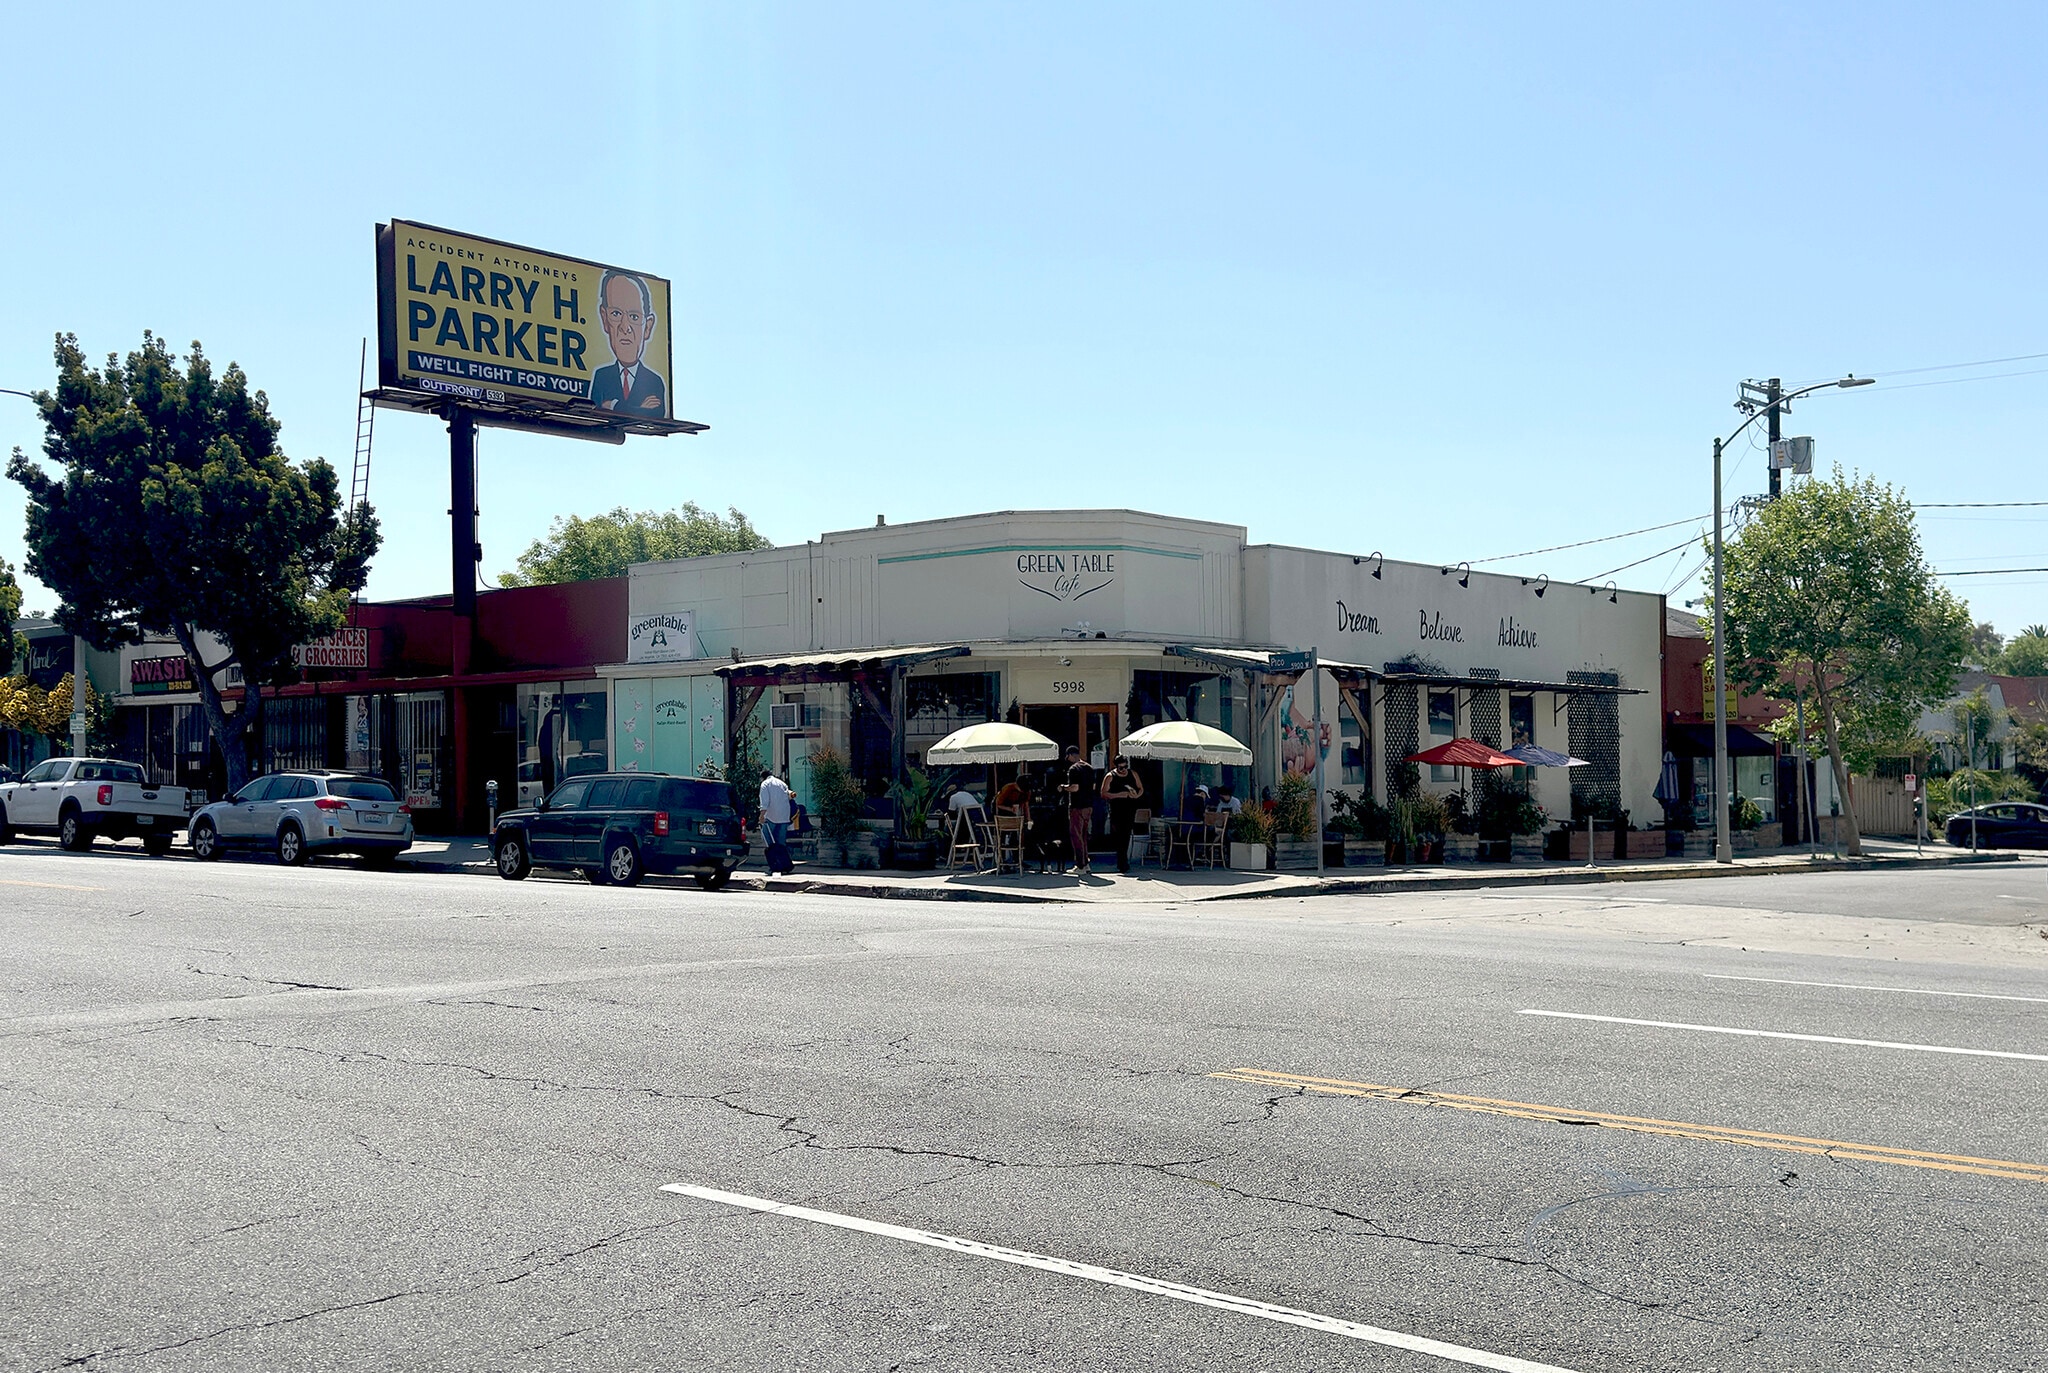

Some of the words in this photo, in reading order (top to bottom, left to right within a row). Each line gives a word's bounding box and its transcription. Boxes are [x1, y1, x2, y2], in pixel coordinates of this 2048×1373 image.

[407, 238, 484, 262] ACCIDENT
[494, 257, 577, 282] ATTORNEYS
[407, 254, 540, 314] LARRY
[553, 284, 586, 325] H.
[408, 300, 587, 371] PARKER
[421, 379, 480, 397] OUTFRONT
[488, 390, 504, 401] 5392
[469, 363, 512, 382] FIGHT
[518, 371, 546, 387] FOR
[550, 377, 583, 393] YOU!
[1017, 554, 1065, 573] GREEN
[1072, 554, 1114, 573] TABLE
[631, 614, 687, 641] greentable
[1336, 599, 1383, 635] Dream.
[1418, 608, 1465, 643] Believe.
[330, 629, 366, 647] SPICES
[1497, 616, 1540, 648] Achieve.
[131, 656, 187, 683] AWASH
[306, 647, 366, 666] GROCERIES
[1053, 681, 1085, 693] 5998
[1704, 684, 1736, 693] SAON
